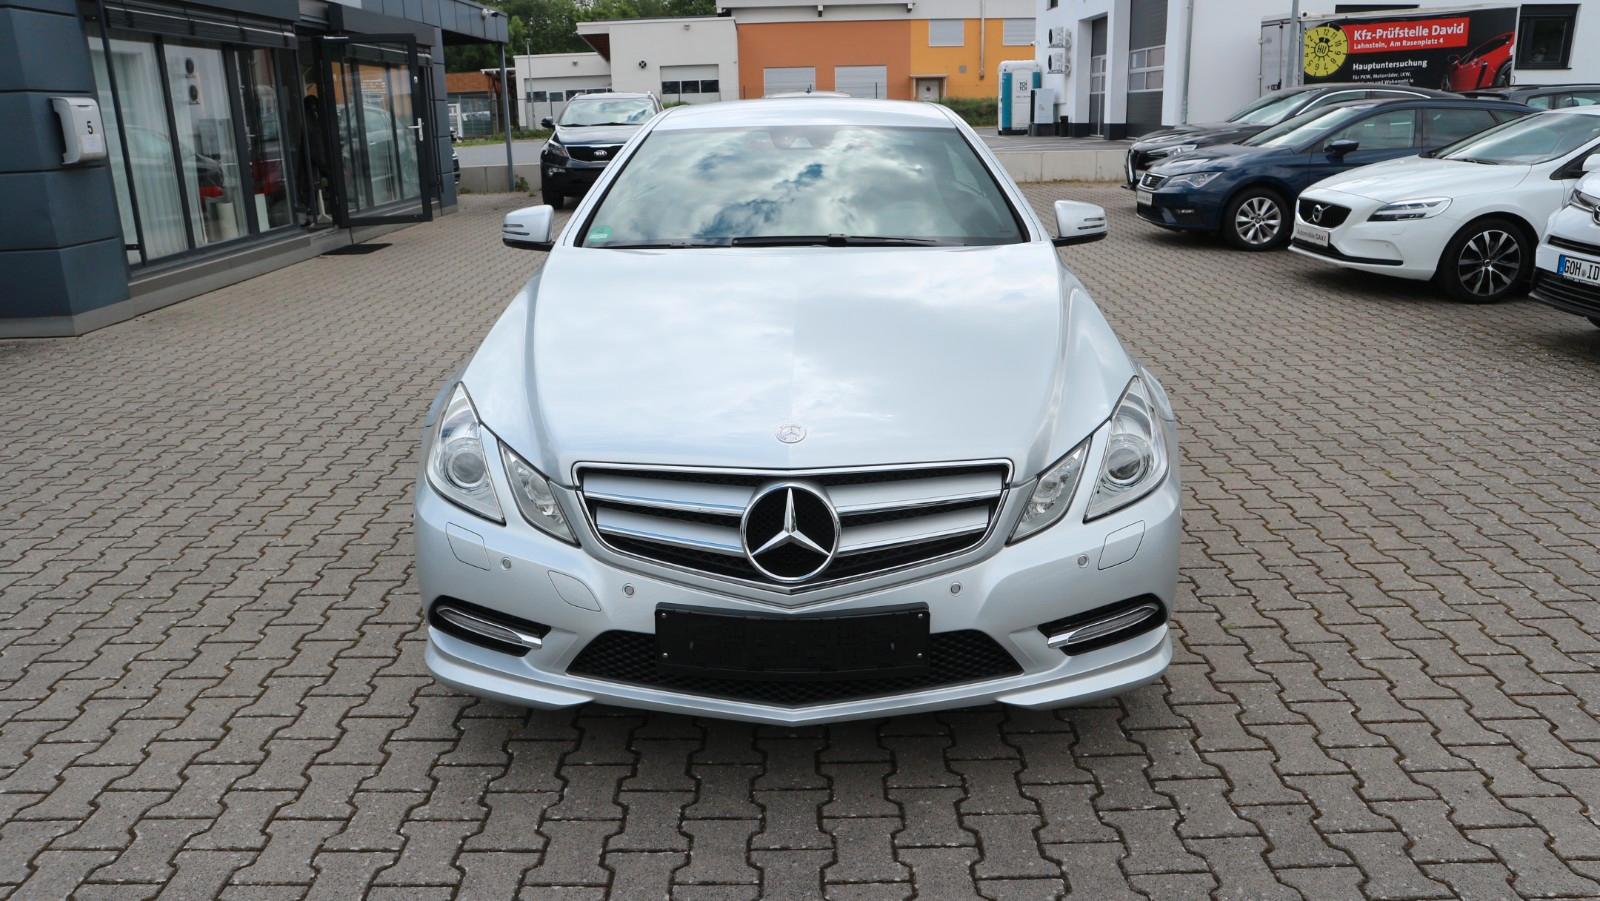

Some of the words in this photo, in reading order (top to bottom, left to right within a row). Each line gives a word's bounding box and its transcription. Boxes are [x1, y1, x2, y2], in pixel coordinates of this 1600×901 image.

[1353, 26, 1429, 40] Kfz-Prüfstelle
[1431, 22, 1464, 36] David
[1353, 40, 1388, 49] Lahnstein,
[1402, 37, 1438, 47] Rasenplatz
[1352, 59, 1428, 71] Hauptuntersuchung
[86, 120, 94, 135] 5
[1564, 259, 1582, 277] GOH
